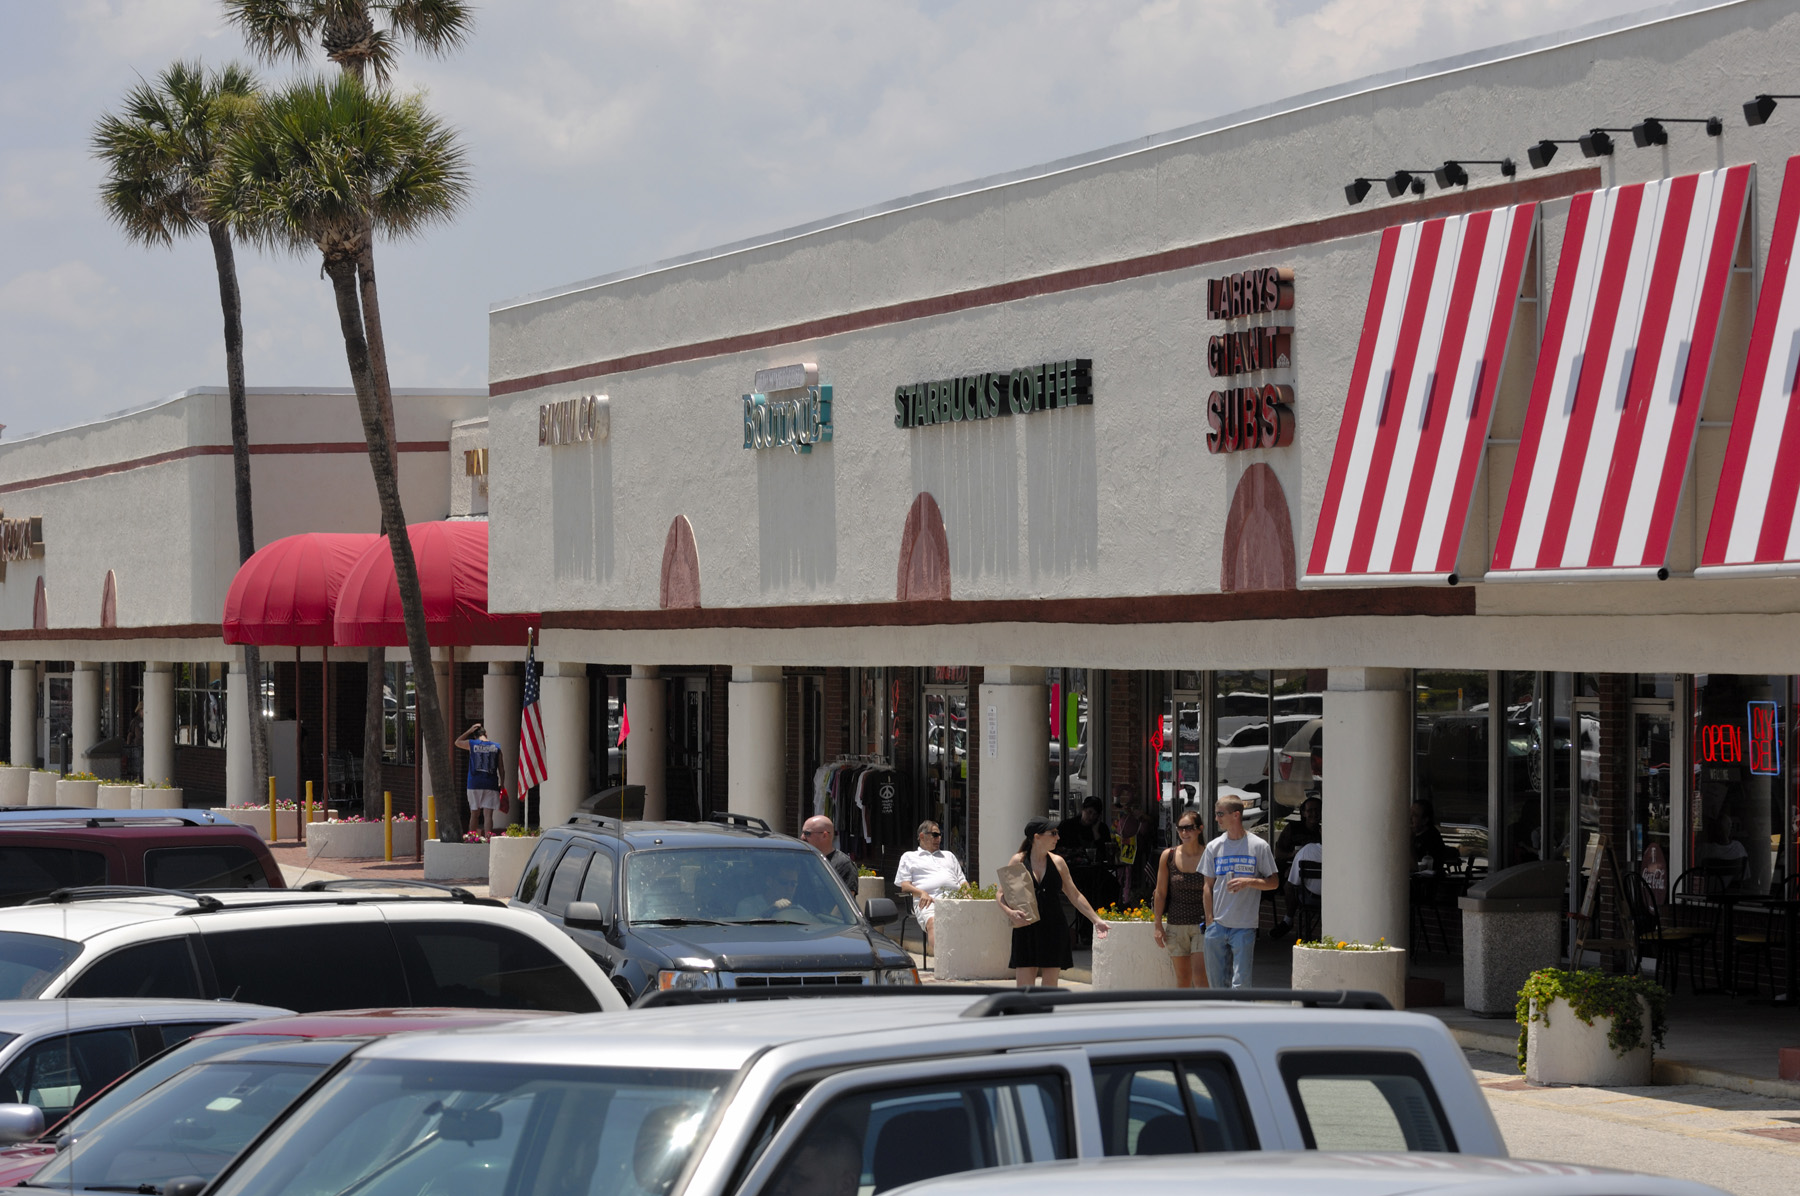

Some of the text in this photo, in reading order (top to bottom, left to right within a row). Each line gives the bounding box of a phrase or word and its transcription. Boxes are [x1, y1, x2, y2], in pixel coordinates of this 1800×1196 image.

[1207, 266, 1284, 320] LARRYS
[1207, 326, 1284, 377] GIANT
[894, 359, 1083, 429] STARBUCKS COFFEE
[1206, 383, 1286, 455] SUBS
[538, 400, 577, 447] BIKINI
[1702, 724, 1742, 763] OPEN
